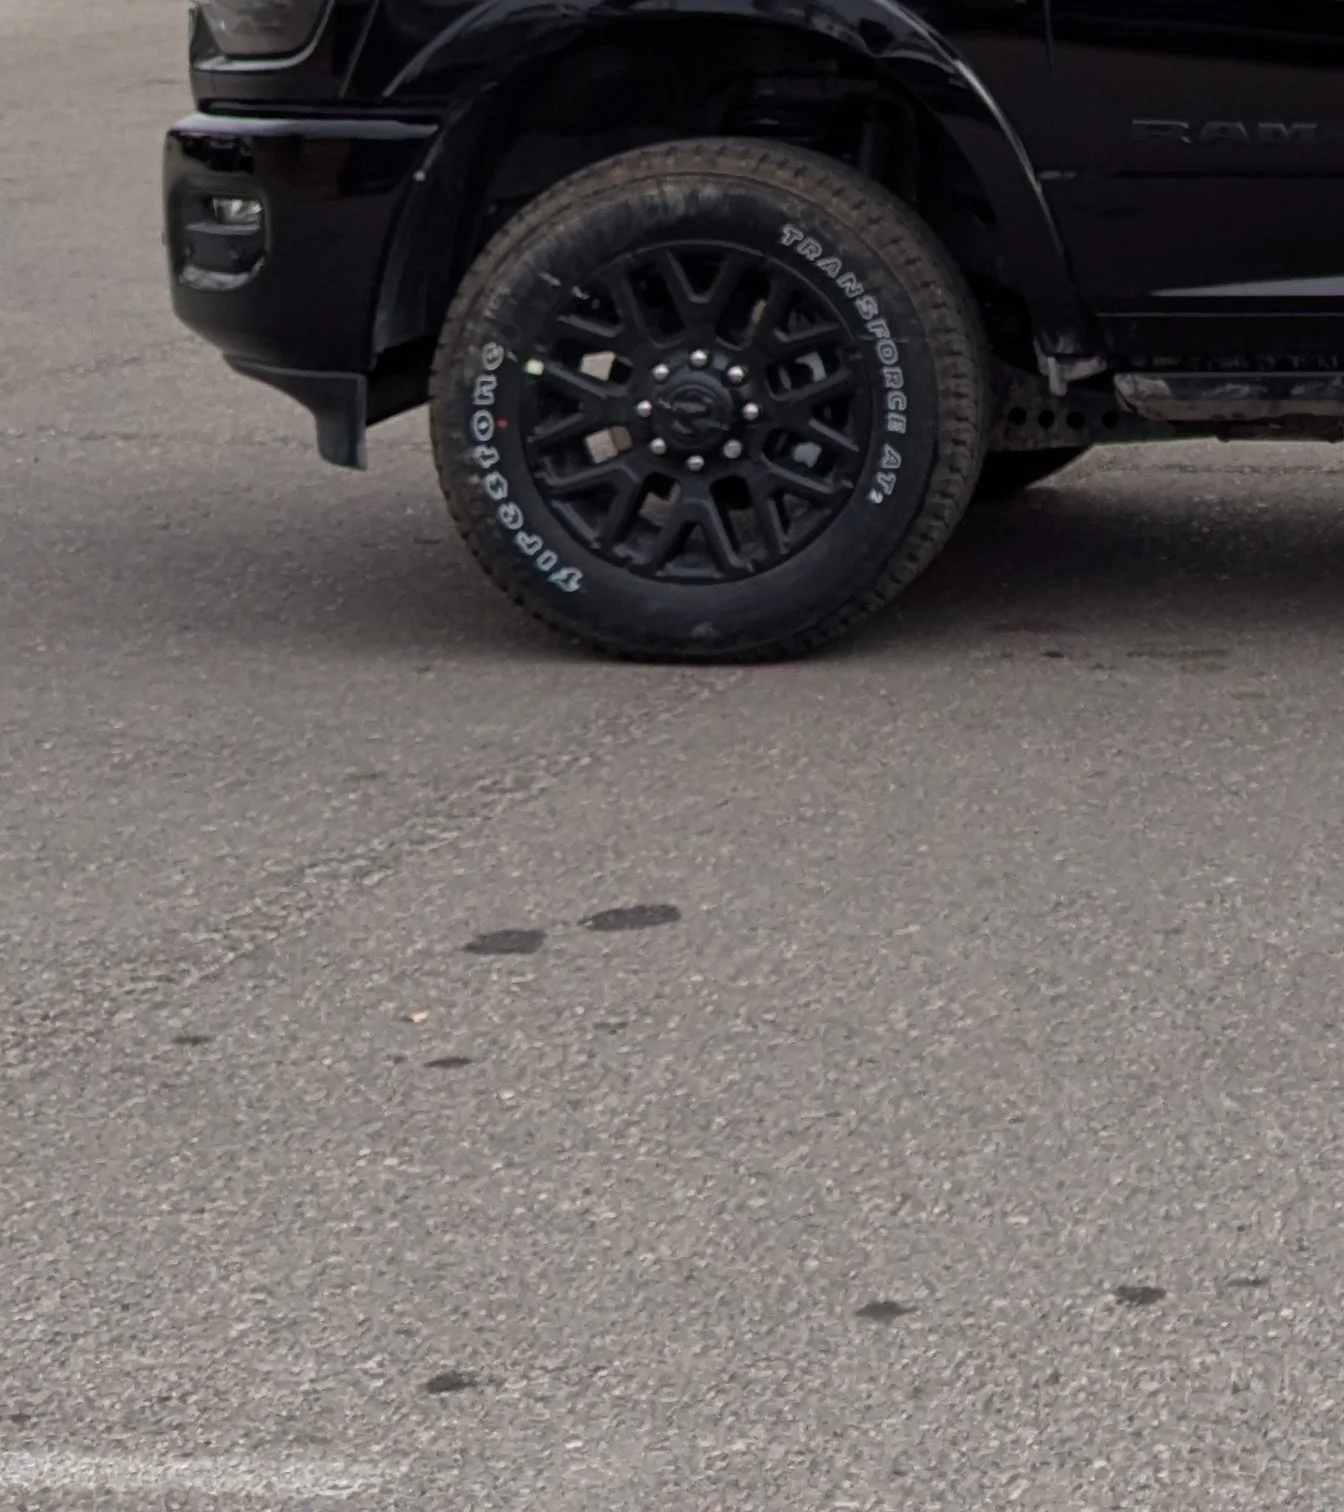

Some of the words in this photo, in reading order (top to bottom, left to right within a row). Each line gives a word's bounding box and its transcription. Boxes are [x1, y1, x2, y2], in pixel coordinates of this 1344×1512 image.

[1132, 119, 1318, 144] RAM
[779, 224, 907, 434] TRANSFORCE
[471, 342, 584, 592] Firestone
